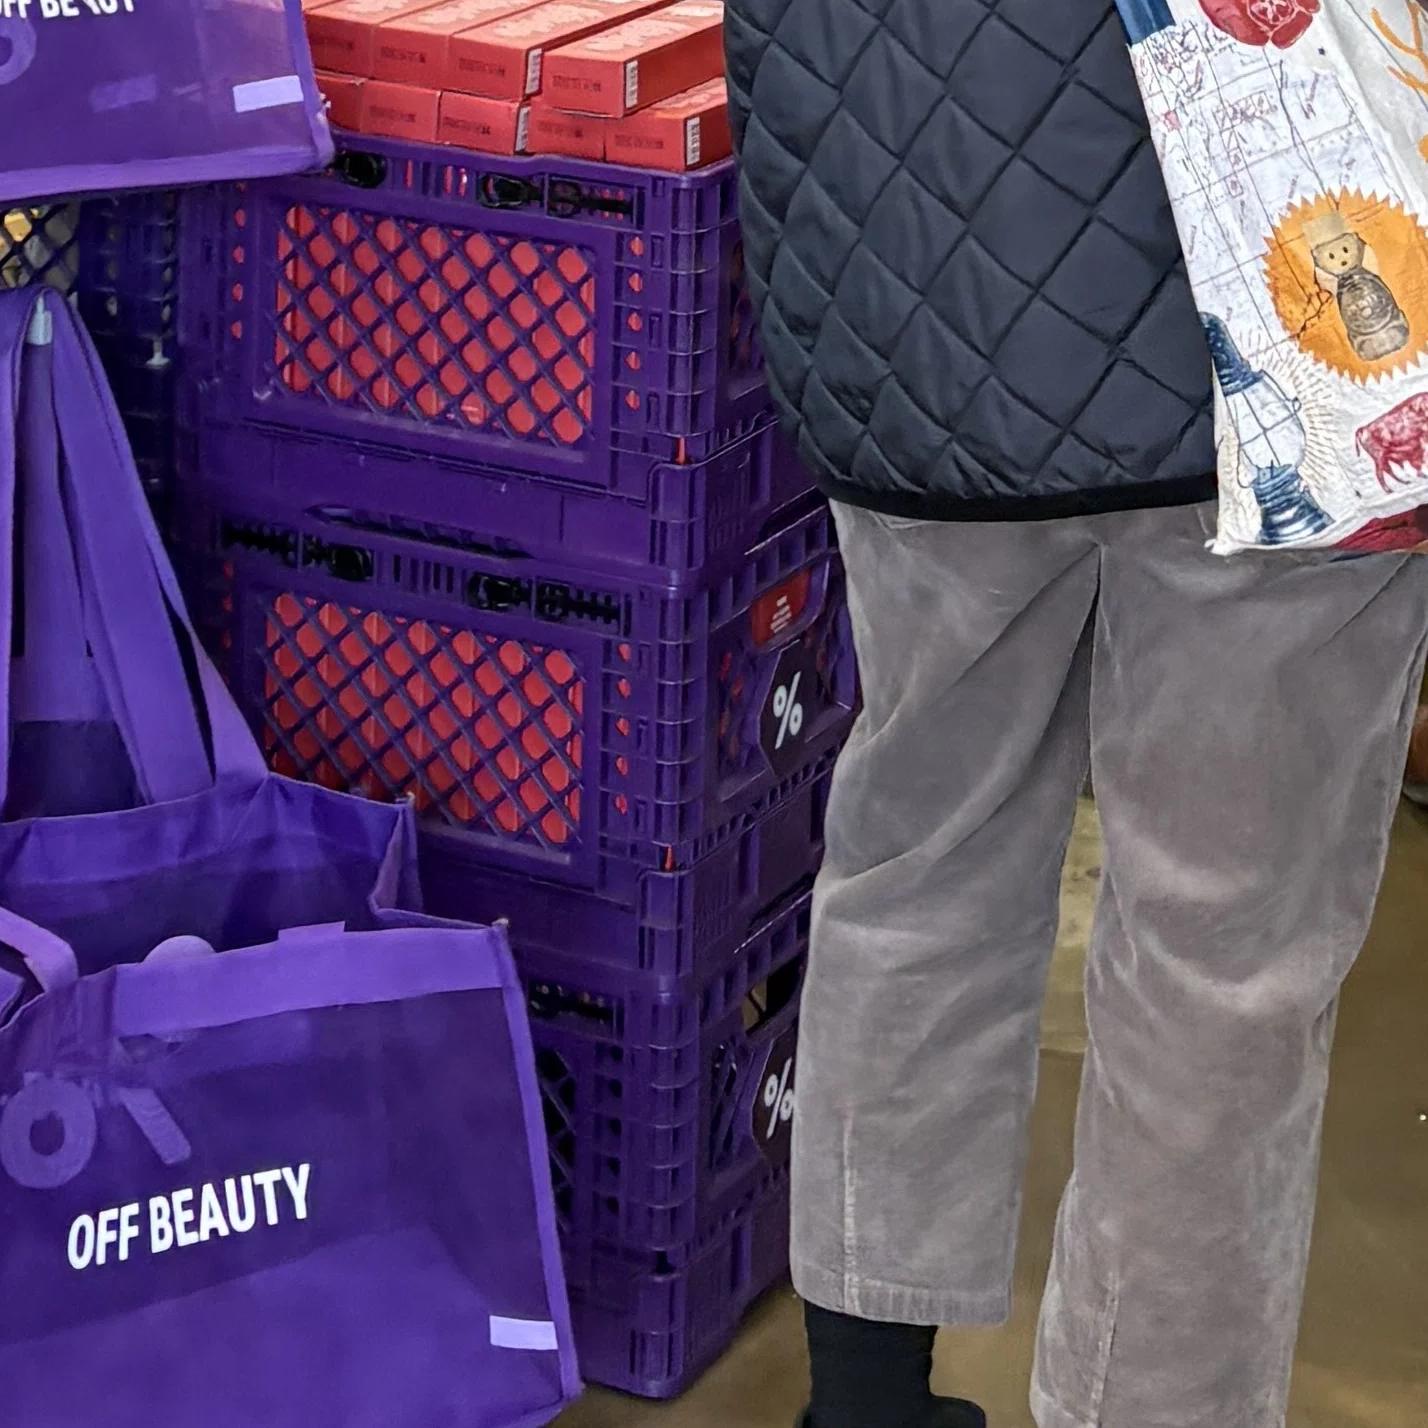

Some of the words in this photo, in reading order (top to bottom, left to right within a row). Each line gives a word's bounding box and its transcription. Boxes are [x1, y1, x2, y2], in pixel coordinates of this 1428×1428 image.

[772, 670, 804, 751] %
[764, 1056, 794, 1141] %
[67, 1202, 140, 1270] OFF
[150, 1162, 311, 1255] BEAUTY
